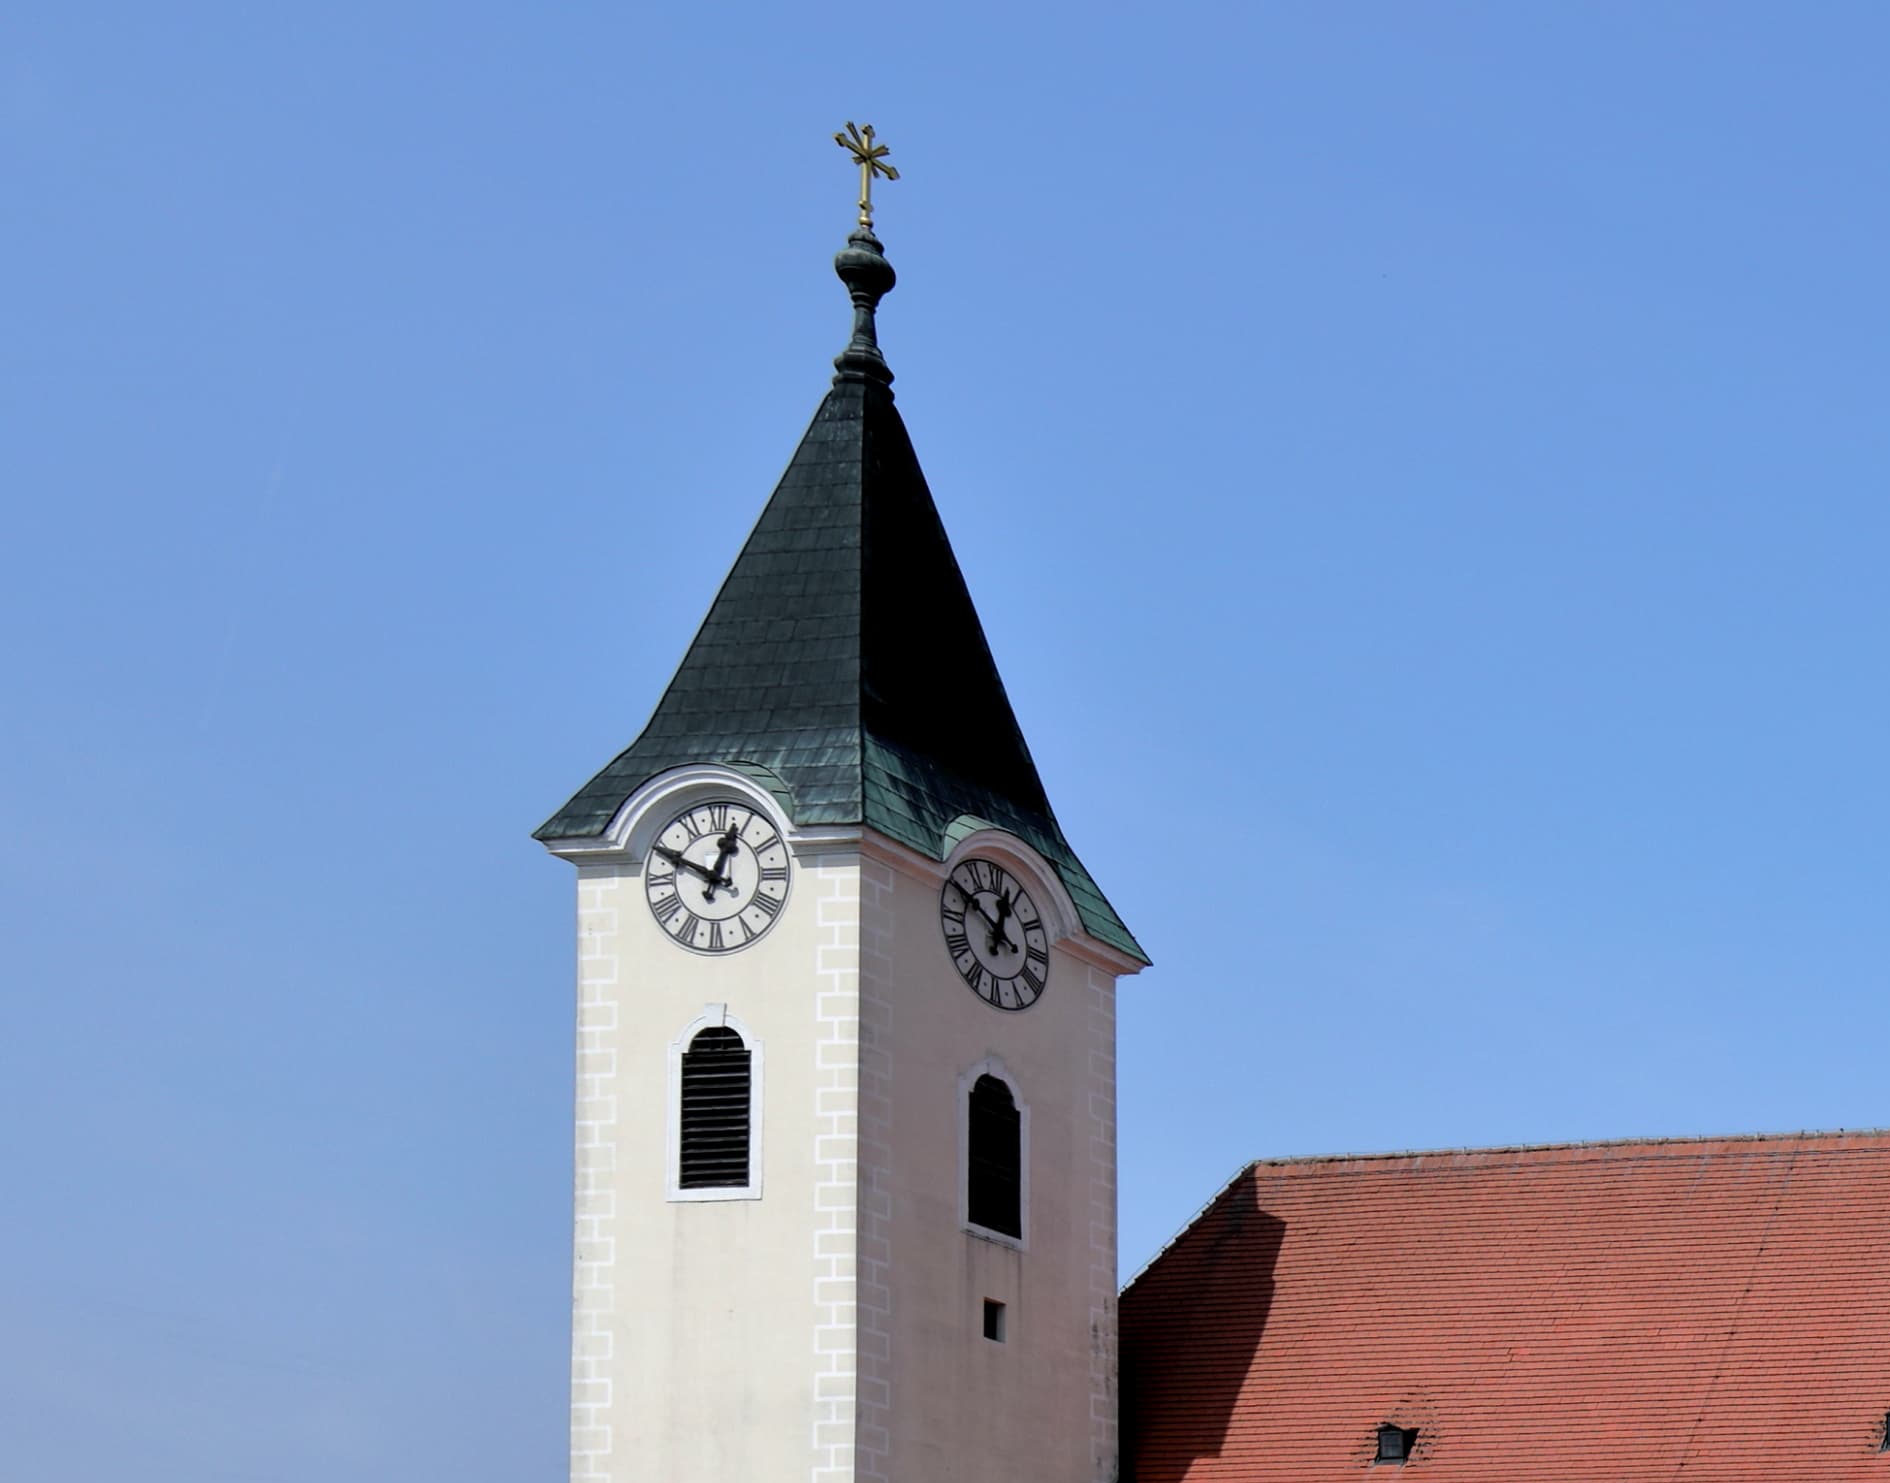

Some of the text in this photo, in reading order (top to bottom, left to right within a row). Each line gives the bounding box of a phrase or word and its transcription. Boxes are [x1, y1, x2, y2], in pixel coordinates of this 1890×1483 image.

[678, 813, 703, 841] XI
[708, 806, 729, 832] XII
[740, 813, 754, 837] I
[754, 834, 780, 855] II
[649, 873, 674, 886] IX
[761, 867, 787, 881] III
[652, 894, 682, 924] VIII
[752, 892, 781, 919] IIII
[676, 914, 699, 944] VII
[709, 922, 724, 949] VI
[738, 915, 757, 941] V
